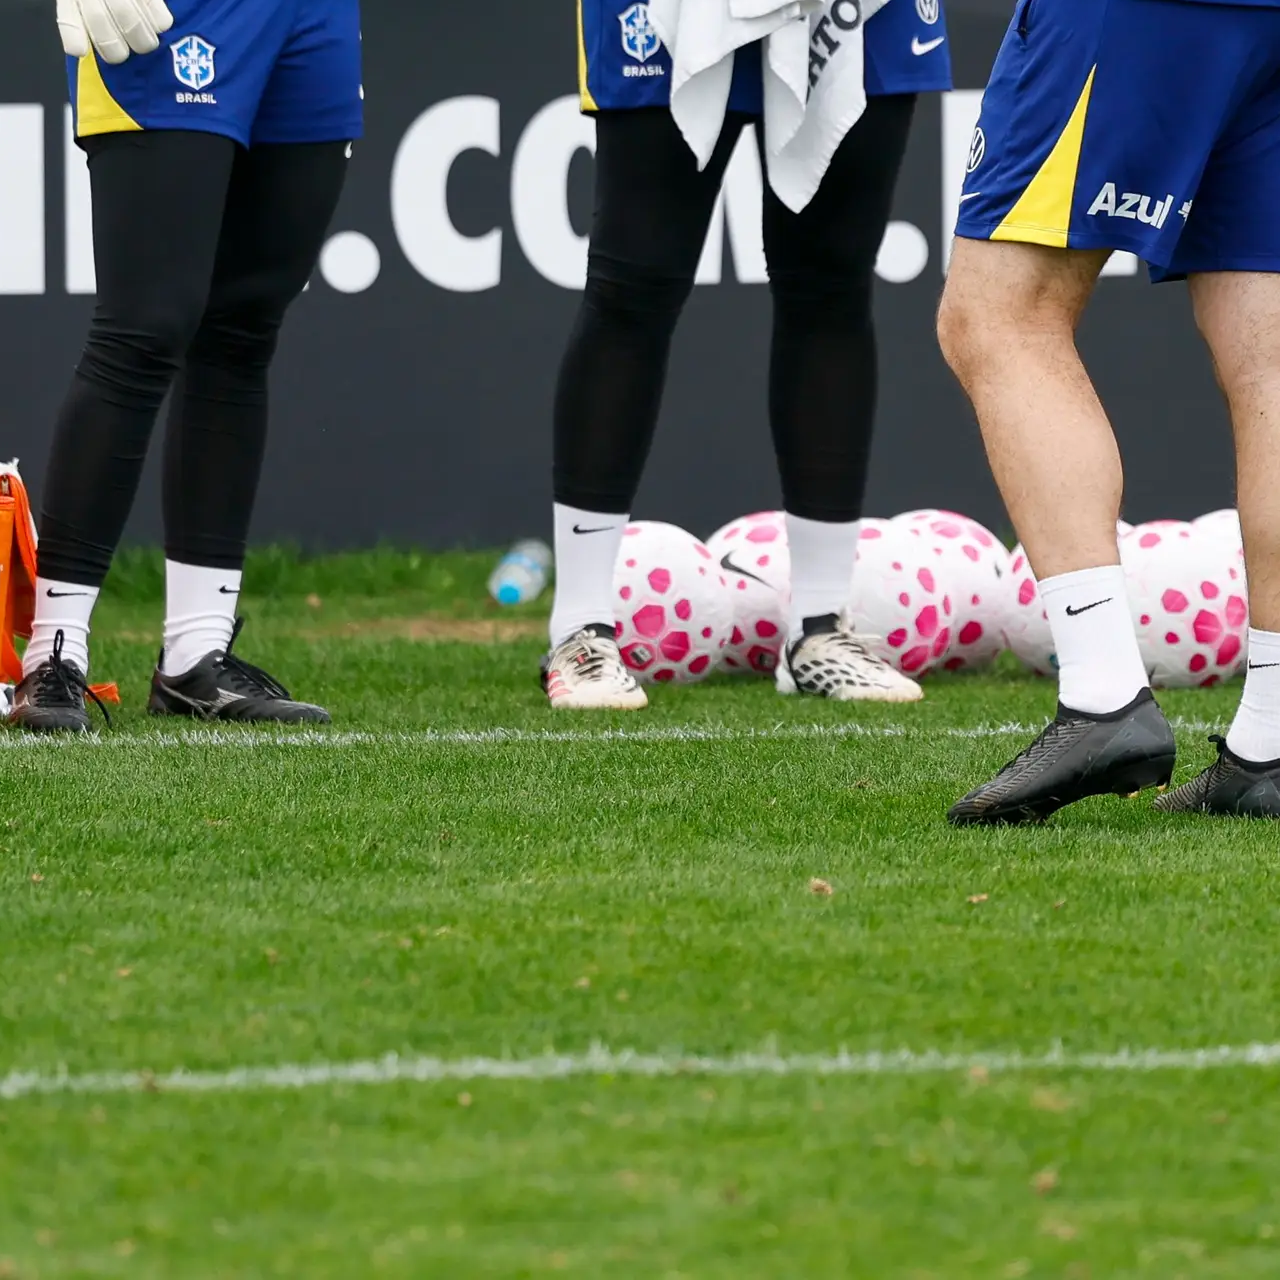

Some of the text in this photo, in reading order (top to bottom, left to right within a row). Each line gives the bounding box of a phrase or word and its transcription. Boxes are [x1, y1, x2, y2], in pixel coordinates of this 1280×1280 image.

[622, 63, 665, 78] BRASIL
[175, 91, 217, 105] BRASIL
[1086, 181, 1175, 230] Azul
